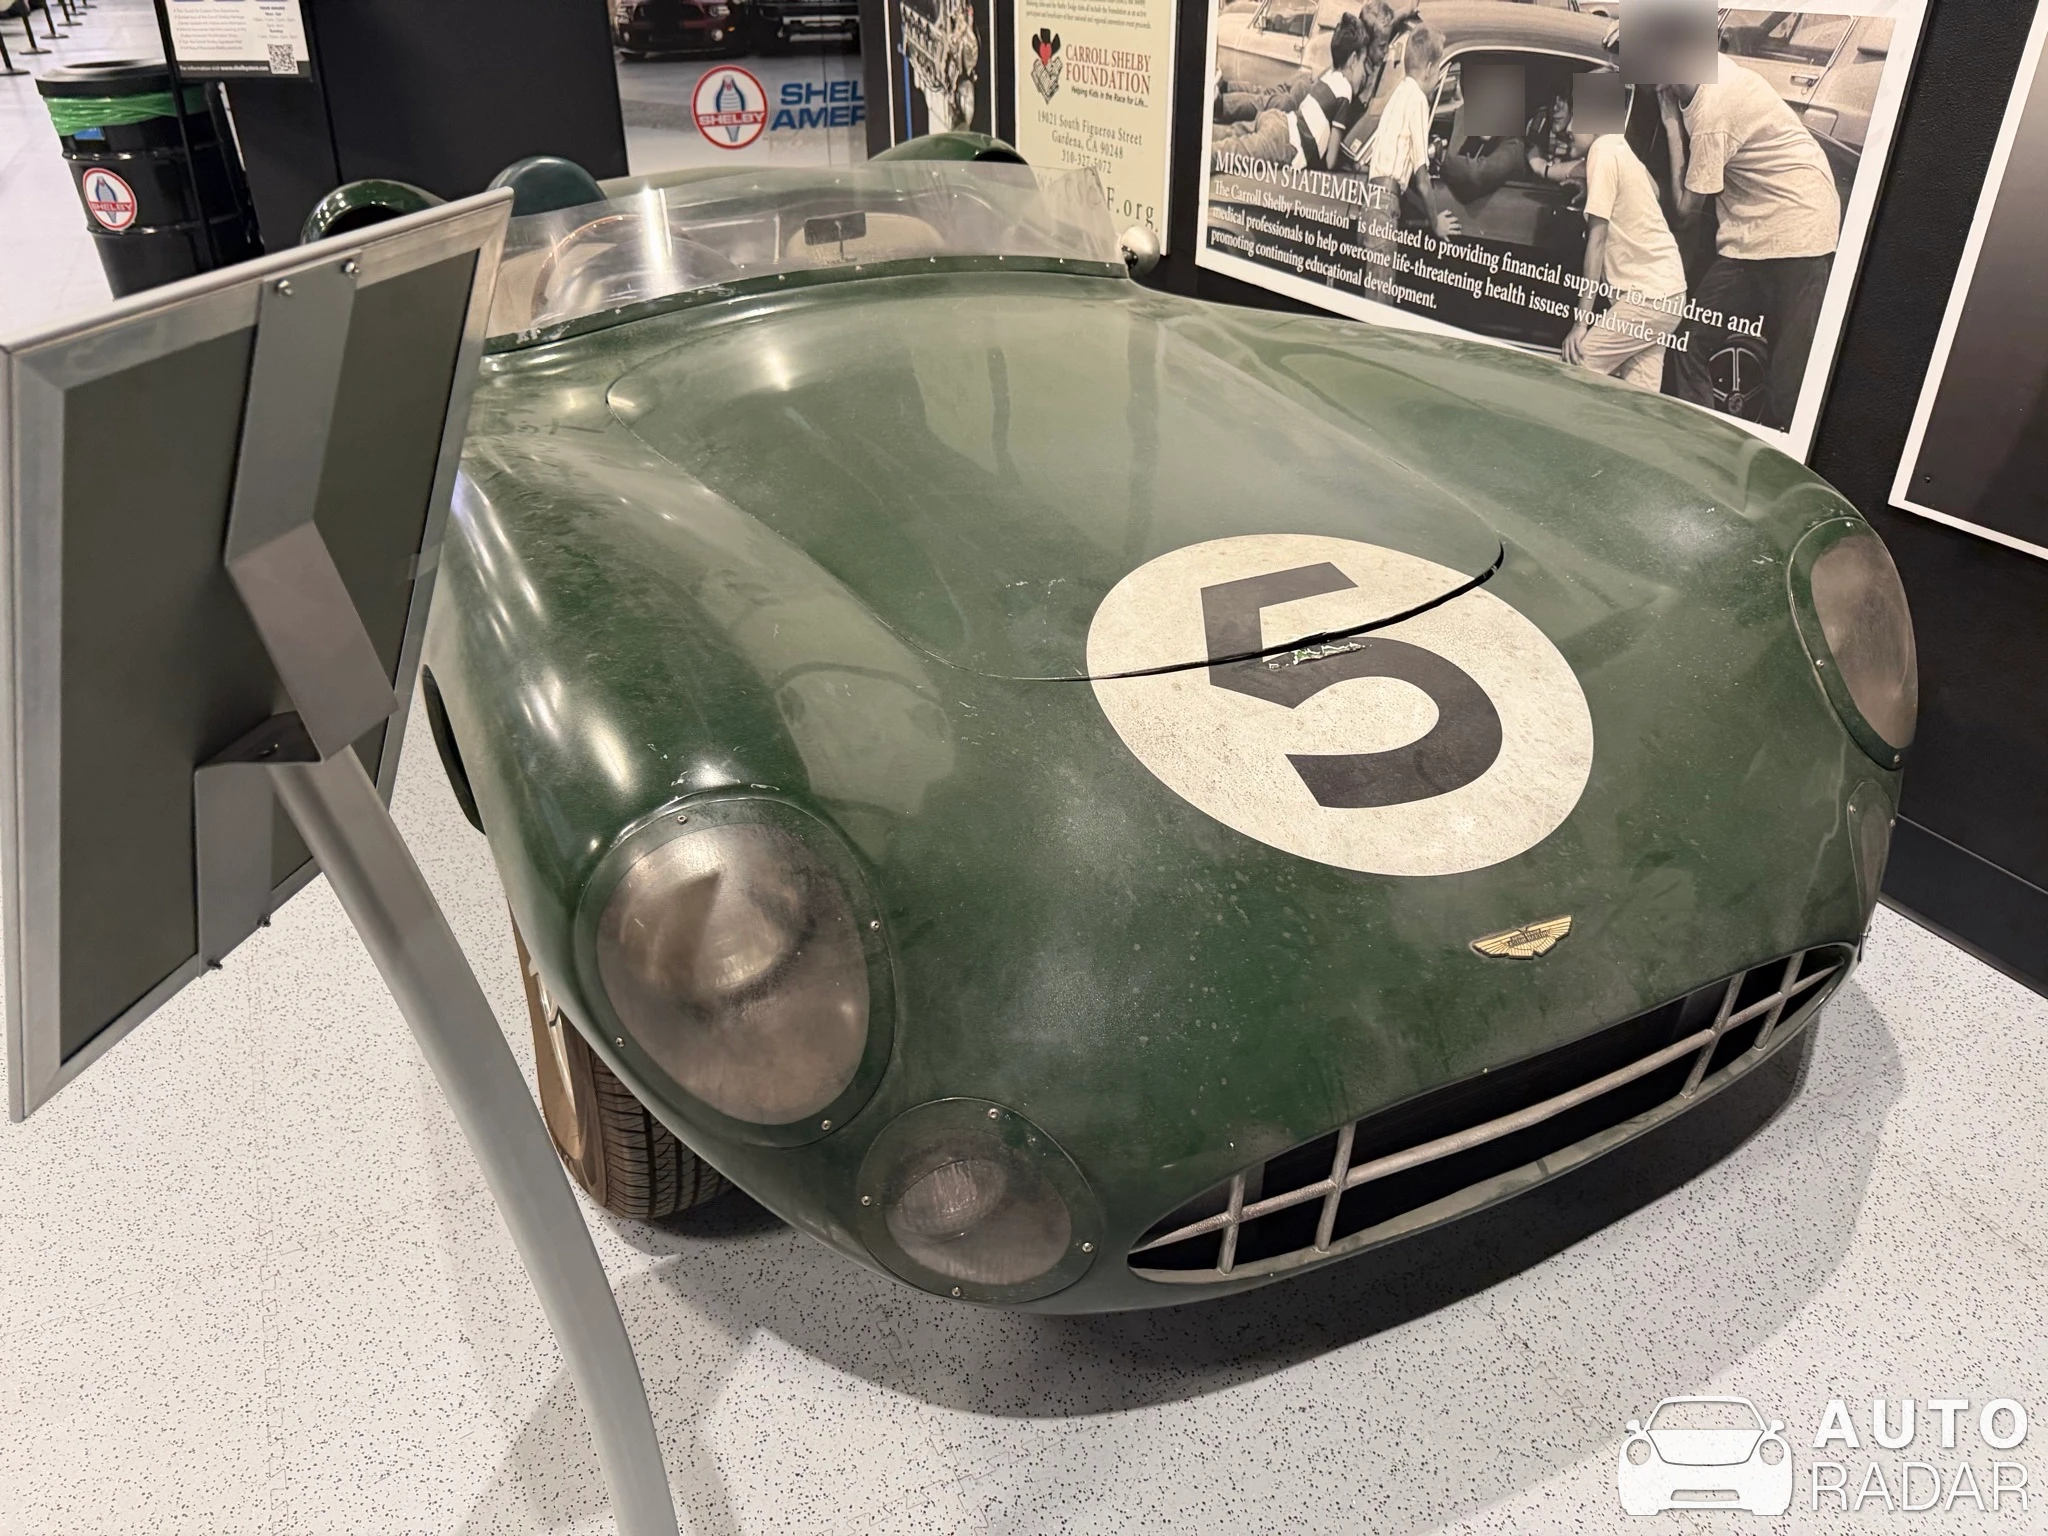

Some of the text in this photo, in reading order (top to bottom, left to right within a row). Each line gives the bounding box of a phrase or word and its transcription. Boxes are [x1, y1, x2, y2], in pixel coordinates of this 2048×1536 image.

[1065, 44, 1151, 73] CARROLL SHELBY
[1065, 62, 1151, 95] FOUNDATION
[1071, 85, 1088, 98] Helping
[1089, 88, 1099, 98] Kids
[1100, 91, 1104, 99] in
[1105, 92, 1113, 101] the
[1114, 93, 1126, 103] Race
[699, 114, 765, 125] SHELBY
[1037, 110, 1142, 146] 19021 South Figueroa Street
[1051, 130, 1124, 159] Gardena, CA 90248
[1215, 150, 1387, 211] MISSION STATEMENT
[91, 202, 133, 212] SHELBY
[1210, 229, 1438, 309] promoting continuing educational development.
[1214, 180, 1230, 198] The
[1230, 183, 1262, 207] Carroll
[1262, 191, 1293, 218] Shelby
[1357, 212, 1367, 234] is
[1368, 218, 1423, 248] dedicated
[1424, 234, 1437, 252] to
[1438, 240, 1500, 274] providing
[1502, 251, 1561, 285] financial
[1563, 272, 1621, 301] support
[1626, 285, 1649, 307] for
[1653, 293, 1723, 328] children
[1727, 315, 1765, 338] and
[1212, 205, 1690, 352] medical professionals to help overcome life-threatening health issues worldwide and
[1200, 561, 1503, 809] 5
